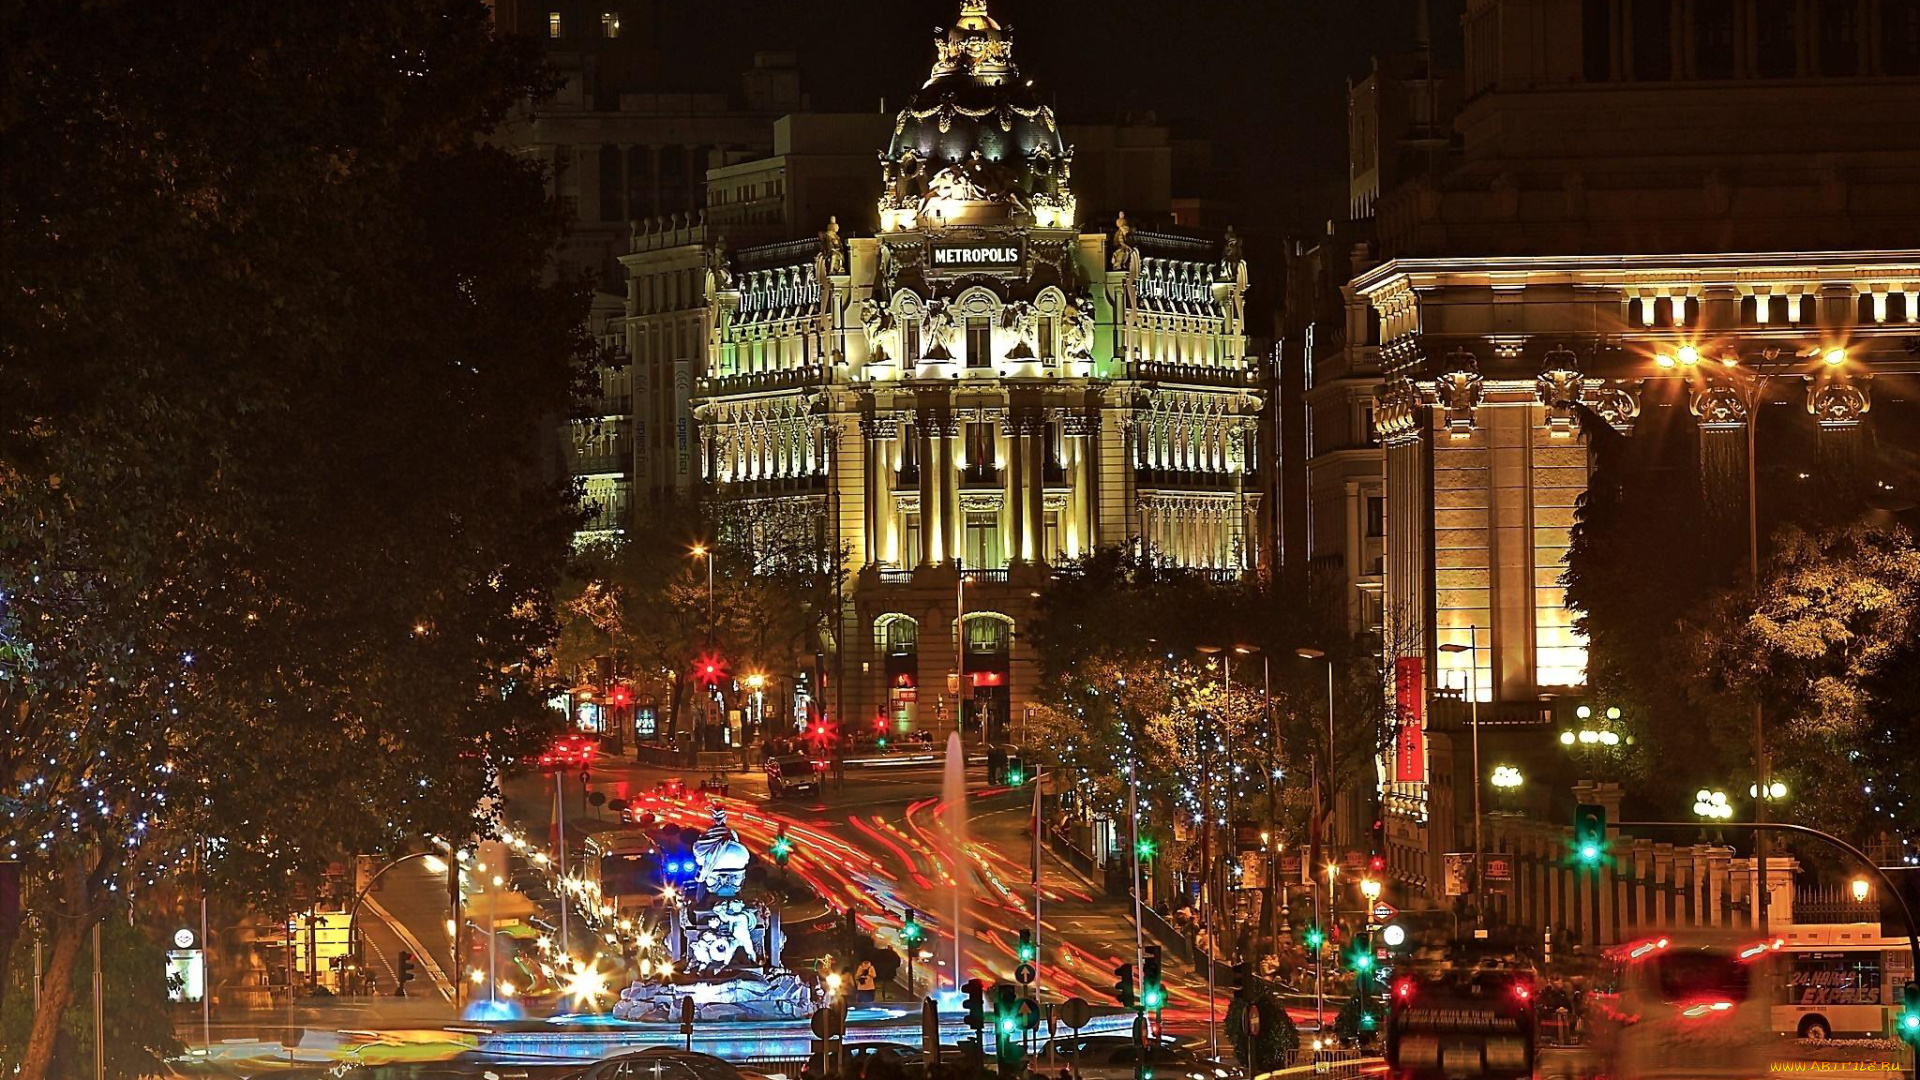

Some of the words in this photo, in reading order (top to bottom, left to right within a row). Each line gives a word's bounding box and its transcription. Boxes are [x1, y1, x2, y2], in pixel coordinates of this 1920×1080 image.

[935, 248, 1018, 263] METROPOLIS
[635, 421, 645, 453] salida
[677, 418, 686, 450] salida
[677, 454, 688, 474] hay
[1792, 972, 1809, 986] 24
[1800, 984, 1879, 1005] EXPRÉS
